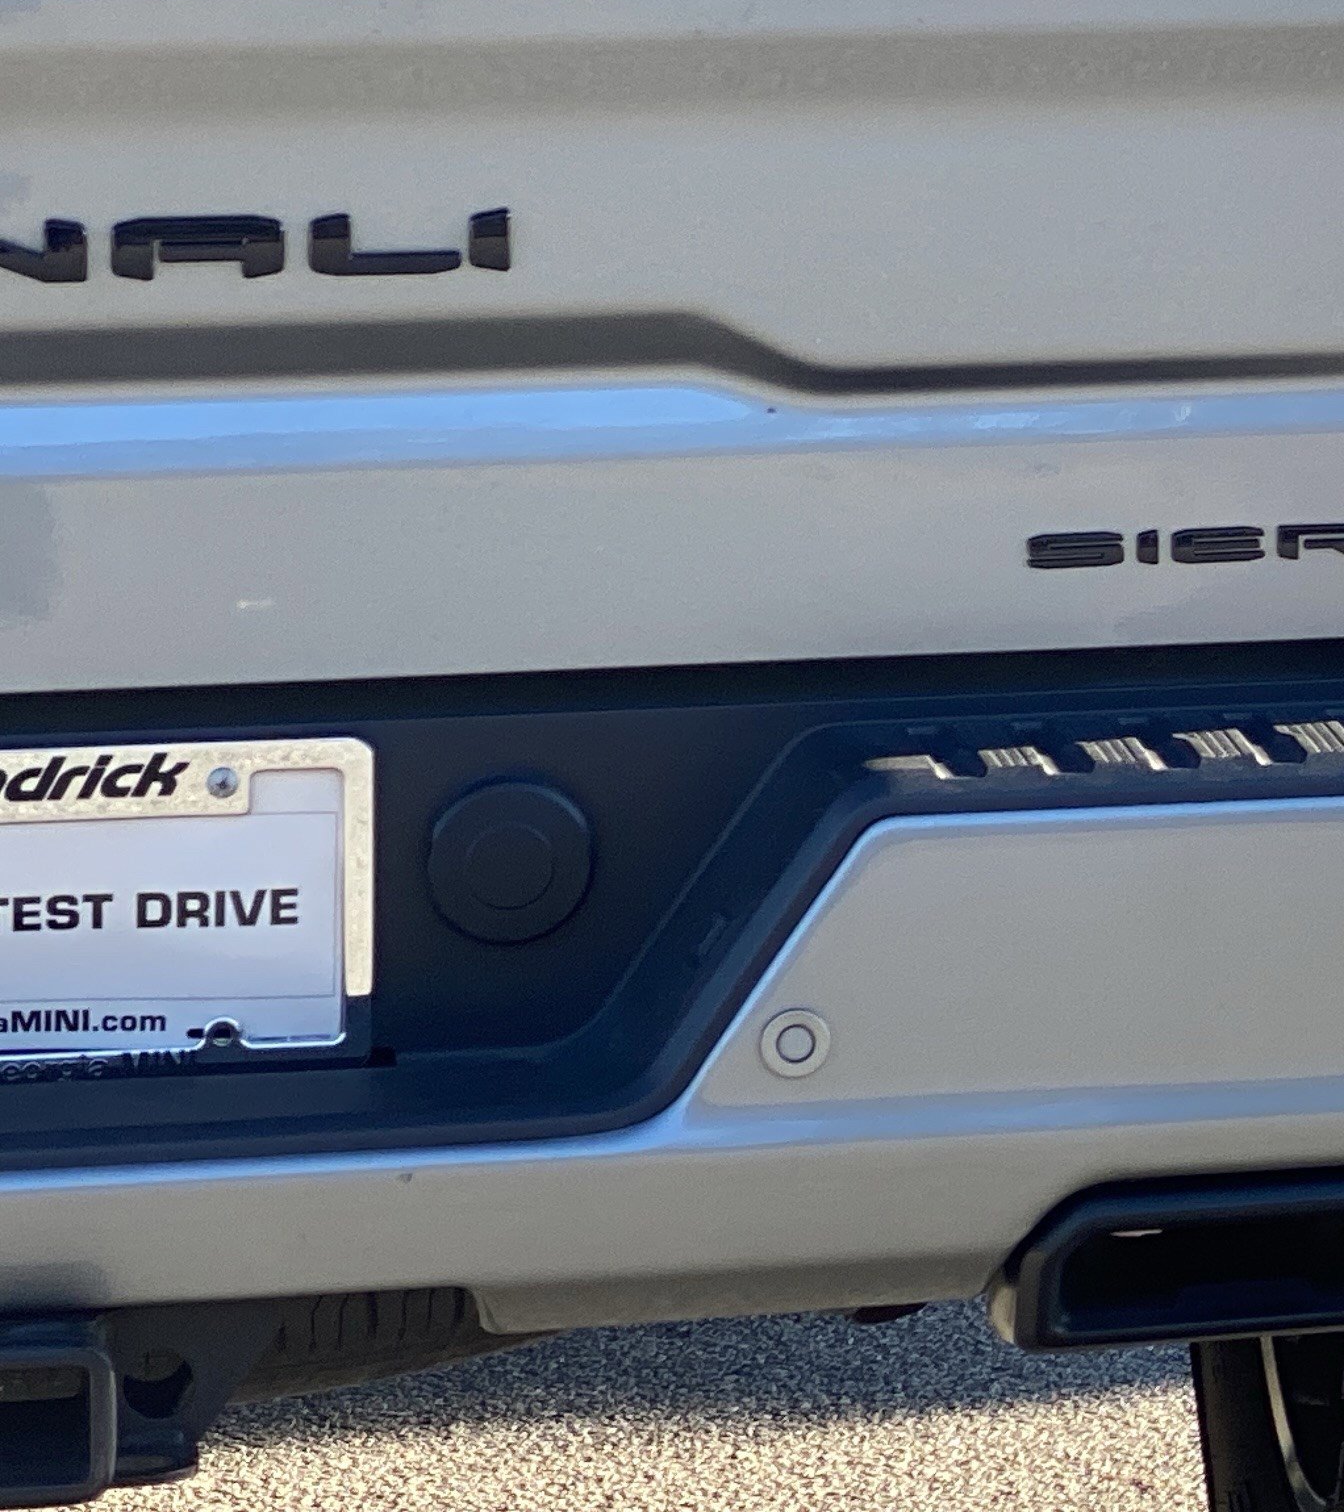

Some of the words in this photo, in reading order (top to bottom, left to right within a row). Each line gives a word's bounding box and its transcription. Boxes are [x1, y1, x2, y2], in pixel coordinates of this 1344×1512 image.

[0, 752, 190, 801] drick
[0, 892, 114, 932] EST
[136, 887, 299, 928] DRIVE
